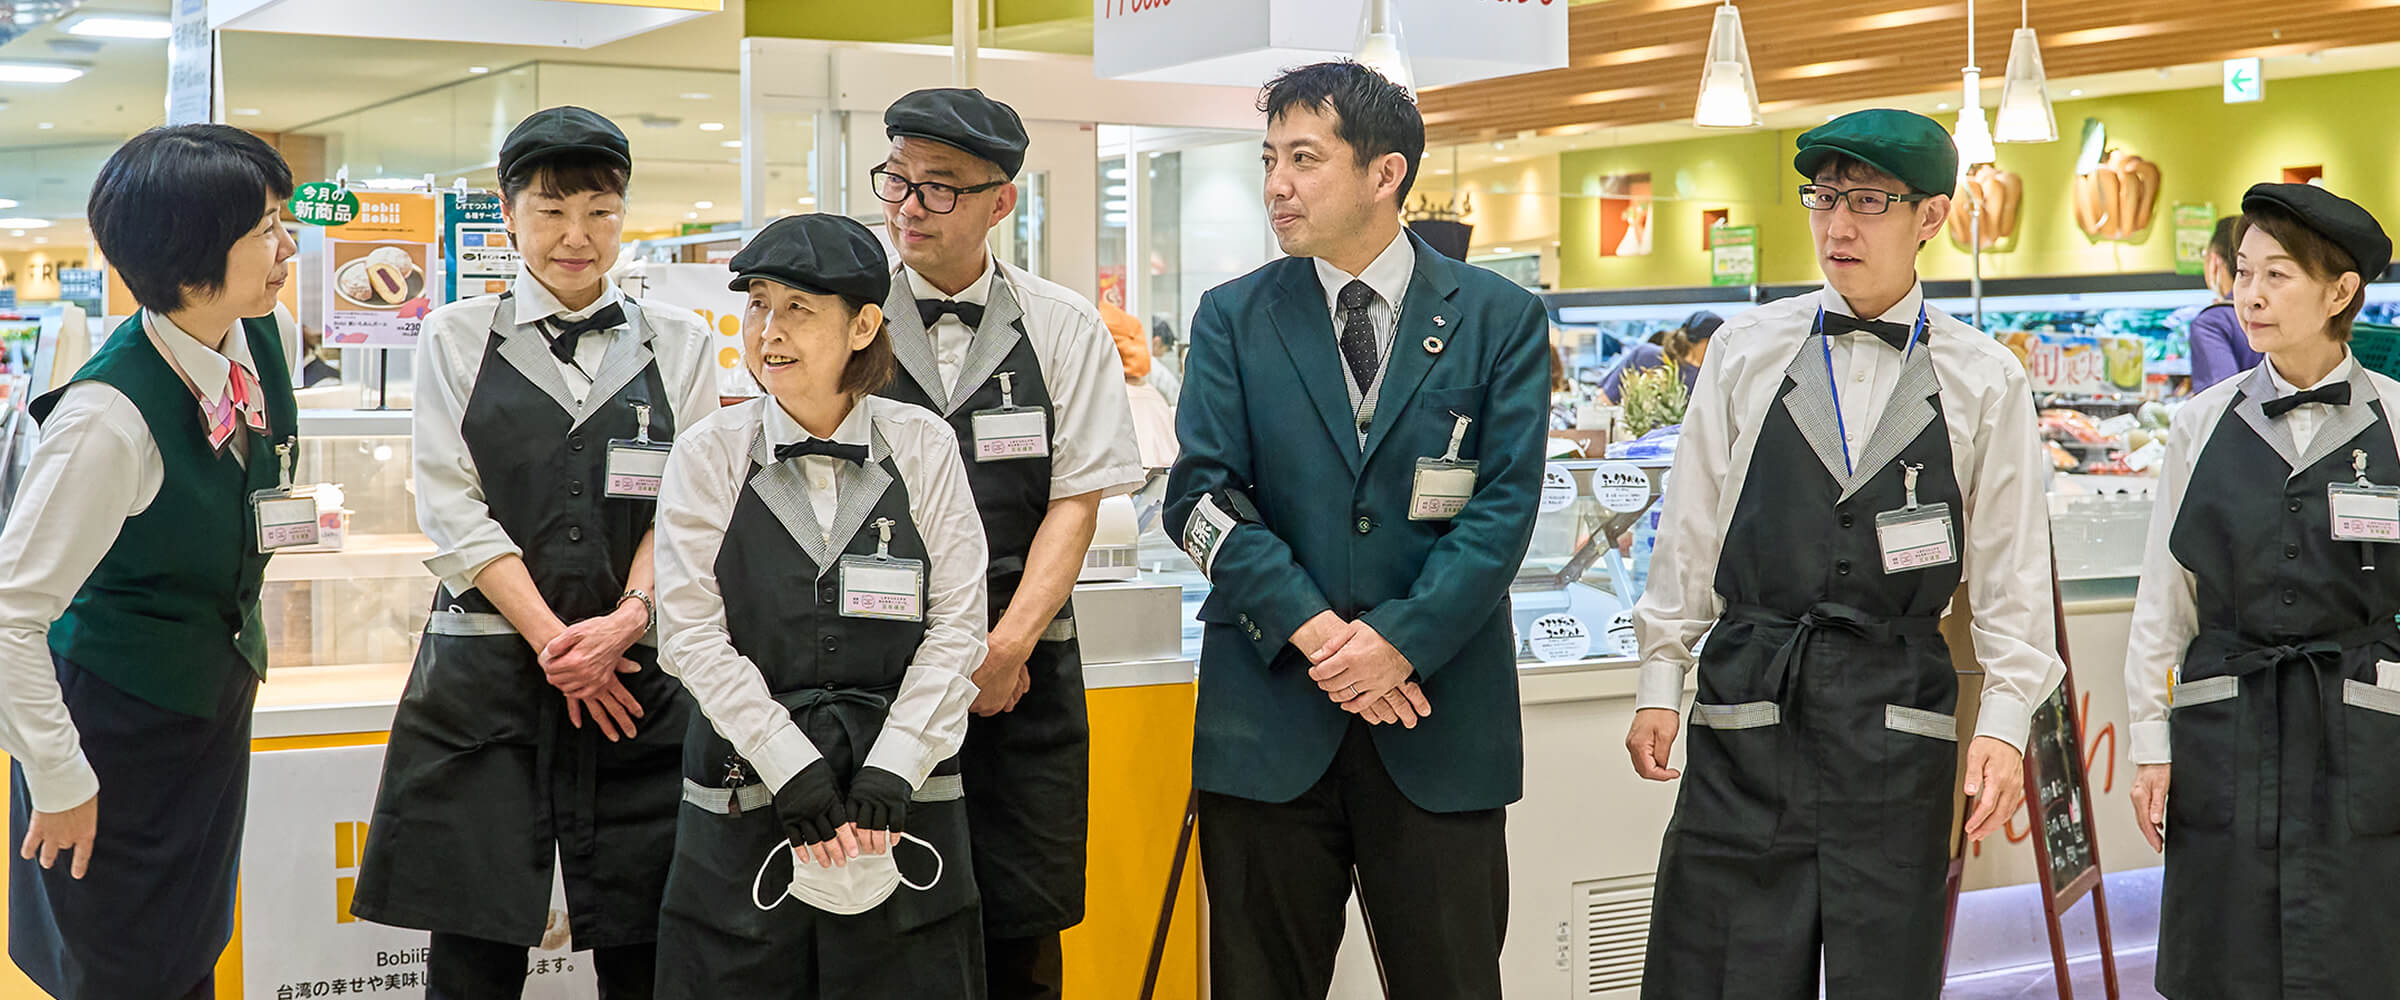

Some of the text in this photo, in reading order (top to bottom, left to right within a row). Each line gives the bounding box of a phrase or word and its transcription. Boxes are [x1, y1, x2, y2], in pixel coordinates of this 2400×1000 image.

[302, 183, 345, 202] 今月の
[295, 200, 352, 222] 新商品
[361, 202, 400, 213] Bobii
[361, 213, 400, 224] Bobii
